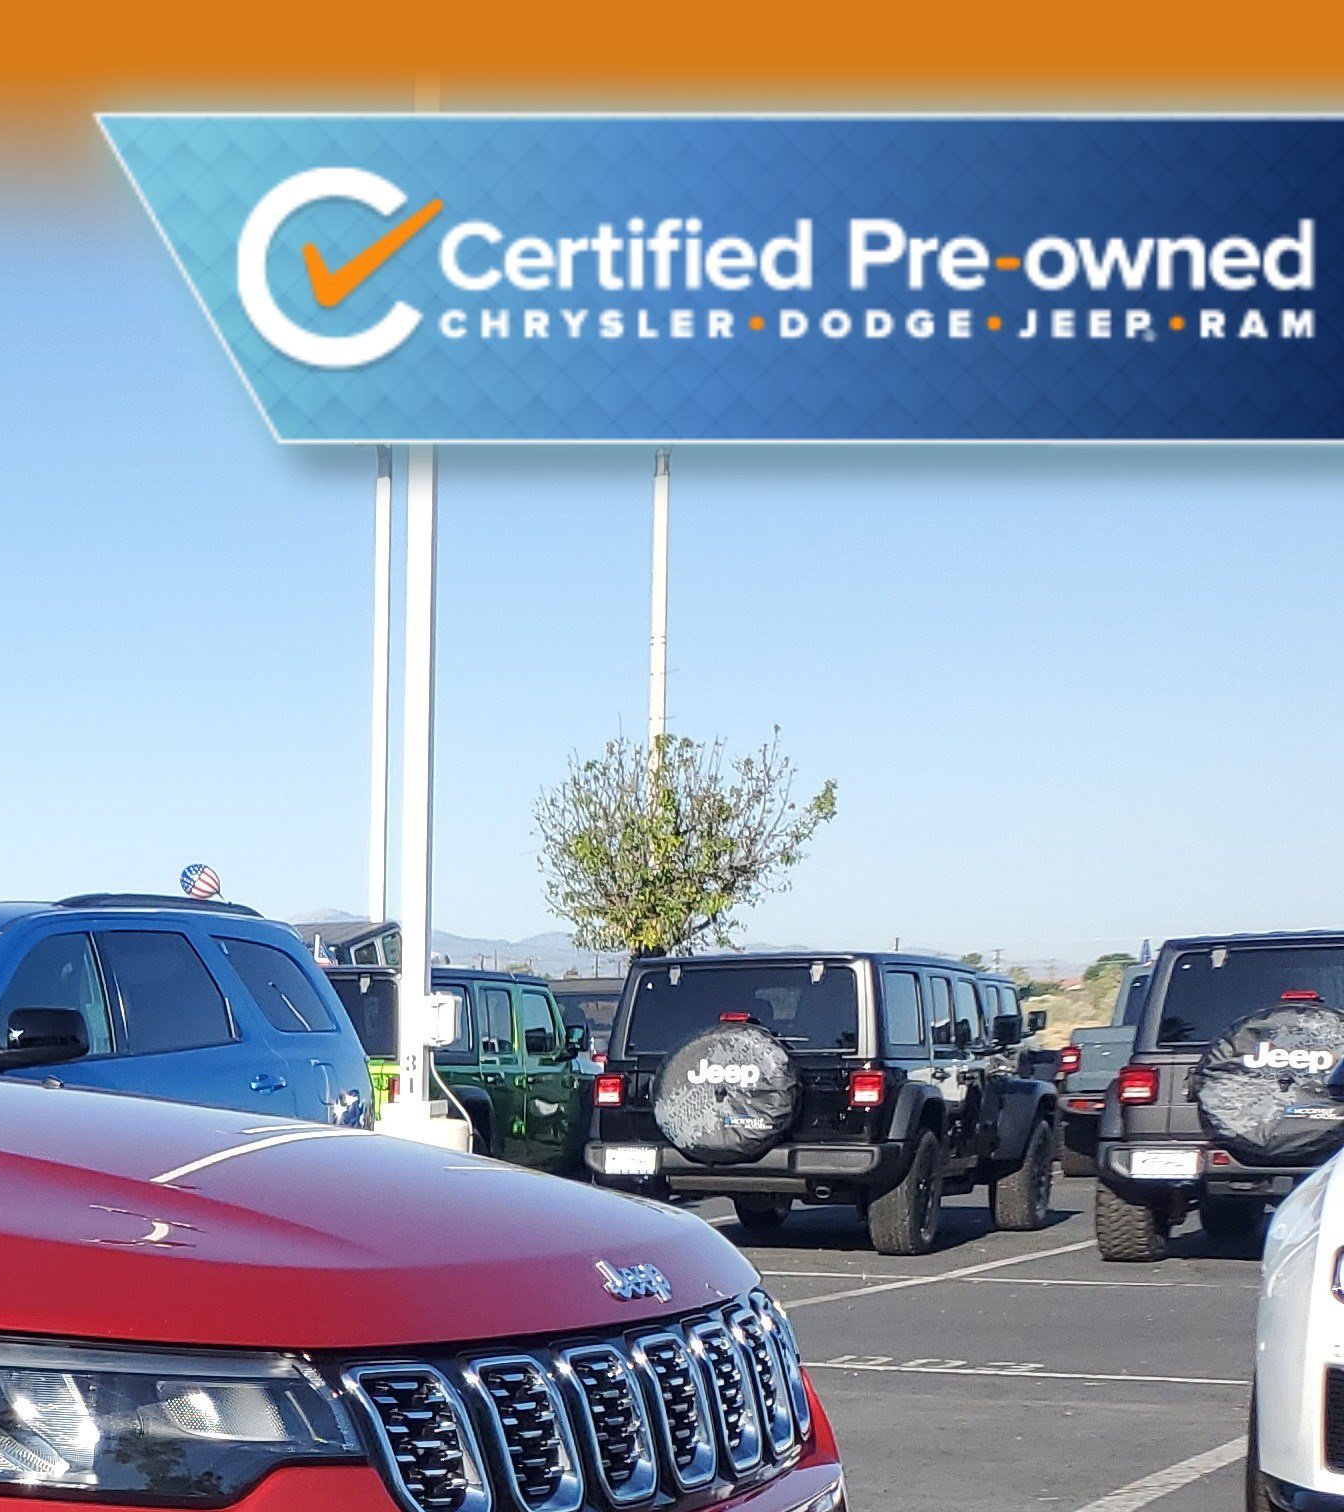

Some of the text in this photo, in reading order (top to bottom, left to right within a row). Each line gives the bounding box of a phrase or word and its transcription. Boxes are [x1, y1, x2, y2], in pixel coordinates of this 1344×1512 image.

[687, 1058, 760, 1088] Jeep
[1242, 1041, 1334, 1074] Jeep
[595, 1259, 673, 1303] Jeep
